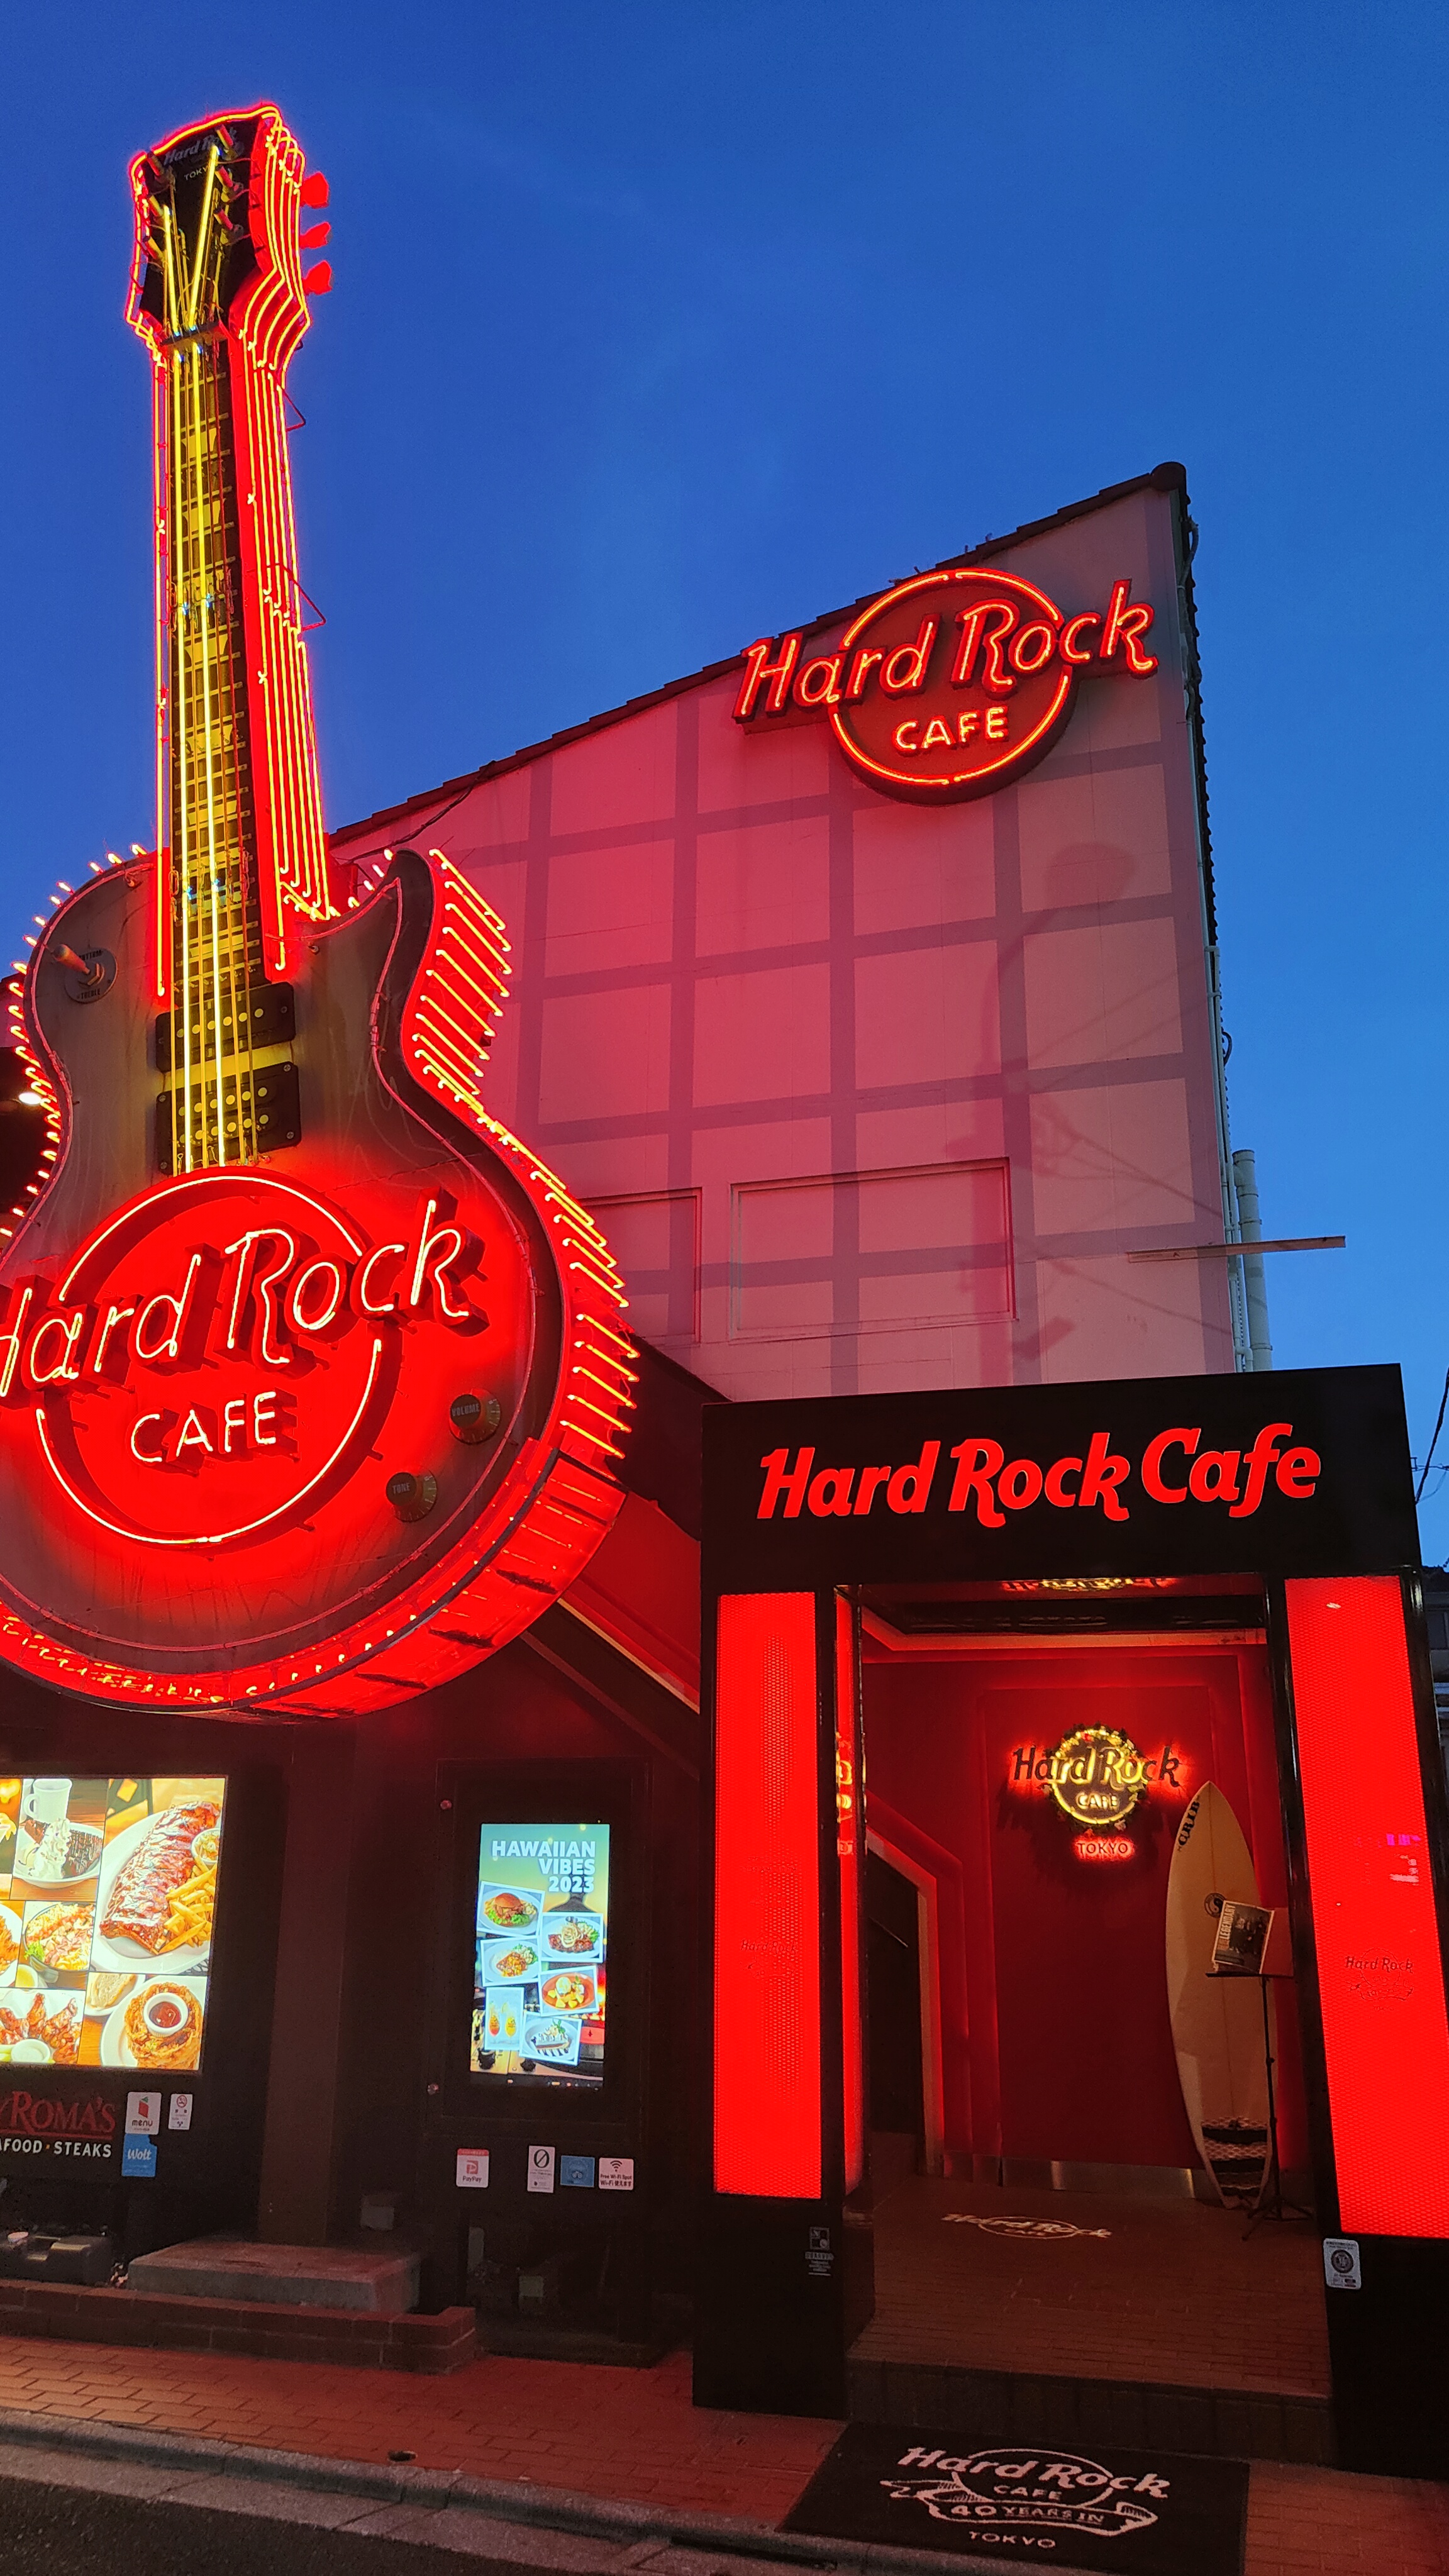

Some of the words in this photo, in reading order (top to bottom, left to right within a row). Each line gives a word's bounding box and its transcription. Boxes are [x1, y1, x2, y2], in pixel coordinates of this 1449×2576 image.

[164, 140, 201, 166] Hard
[184, 165, 211, 180] TOKY
[731, 613, 940, 723] Hard
[950, 580, 1158, 693] Rock
[891, 704, 1009, 754] CAFE
[220, 1191, 476, 1368] Rock
[452, 1403, 480, 1417] VOLUME
[130, 1389, 280, 1464] CAFE
[757, 1440, 941, 1519] Hard
[948, 1432, 1131, 1528] Rock
[1141, 1423, 1321, 1518] Cafe
[392, 1482, 410, 1495] TONE
[1013, 1745, 1096, 1784] Hard
[1099, 1745, 1180, 1791] Rock
[492, 1840, 596, 1858] HAWAIIAN
[1077, 1843, 1129, 1855] TOKYO
[538, 1858, 596, 1875] VIBES
[548, 1876, 594, 1893] 2023
[1219, 1904, 1236, 1940] LEGENDARY
[1345, 1956, 1379, 1970] Hard
[1382, 1957, 1413, 1974] Rock
[0, 2138, 43, 2153] FOOD
[54, 2141, 112, 2158] STEAKS
[127, 2148, 152, 2160] Wolt
[897, 2446, 1039, 2479] Hard
[1038, 2463, 1170, 2498] Rock
[994, 2485, 1063, 2501] CAFE
[951, 2505, 997, 2516] 40
[1004, 2506, 1071, 2519] YEARS
[1076, 2512, 1105, 2526] IN
[969, 2531, 1057, 2549] TOKYO
